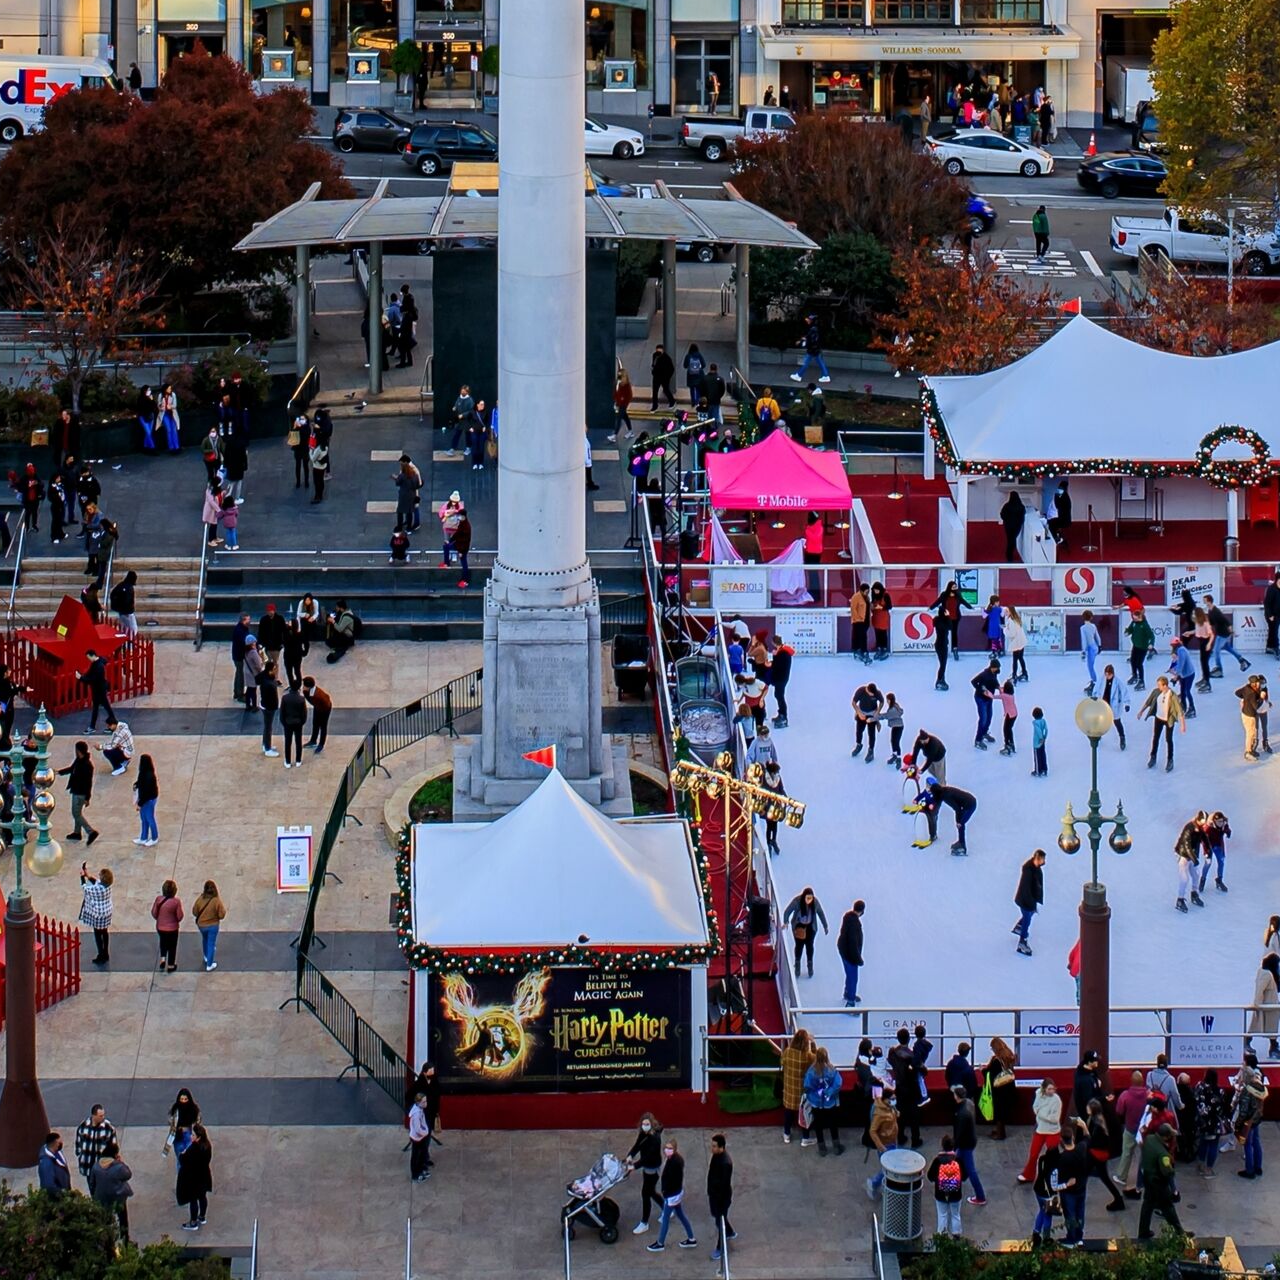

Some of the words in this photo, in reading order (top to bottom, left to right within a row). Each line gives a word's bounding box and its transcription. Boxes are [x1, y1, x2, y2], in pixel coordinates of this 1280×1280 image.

[769, 495, 808, 507] Mobile
[1171, 575, 1196, 587] DEAR
[1172, 583, 1187, 593] SAN
[585, 981, 618, 991] BELIEVE
[621, 981, 632, 989] IN
[573, 990, 612, 1002] MAGIC
[615, 990, 644, 1000] AGAIN
[883, 1019, 927, 1028] GRAND
[549, 1014, 608, 1052] Harry
[608, 1007, 669, 1053] Potter
[574, 1047, 613, 1058] CURSED
[615, 1047, 646, 1056] CHILD
[1179, 1044, 1233, 1052] GALLERIA
